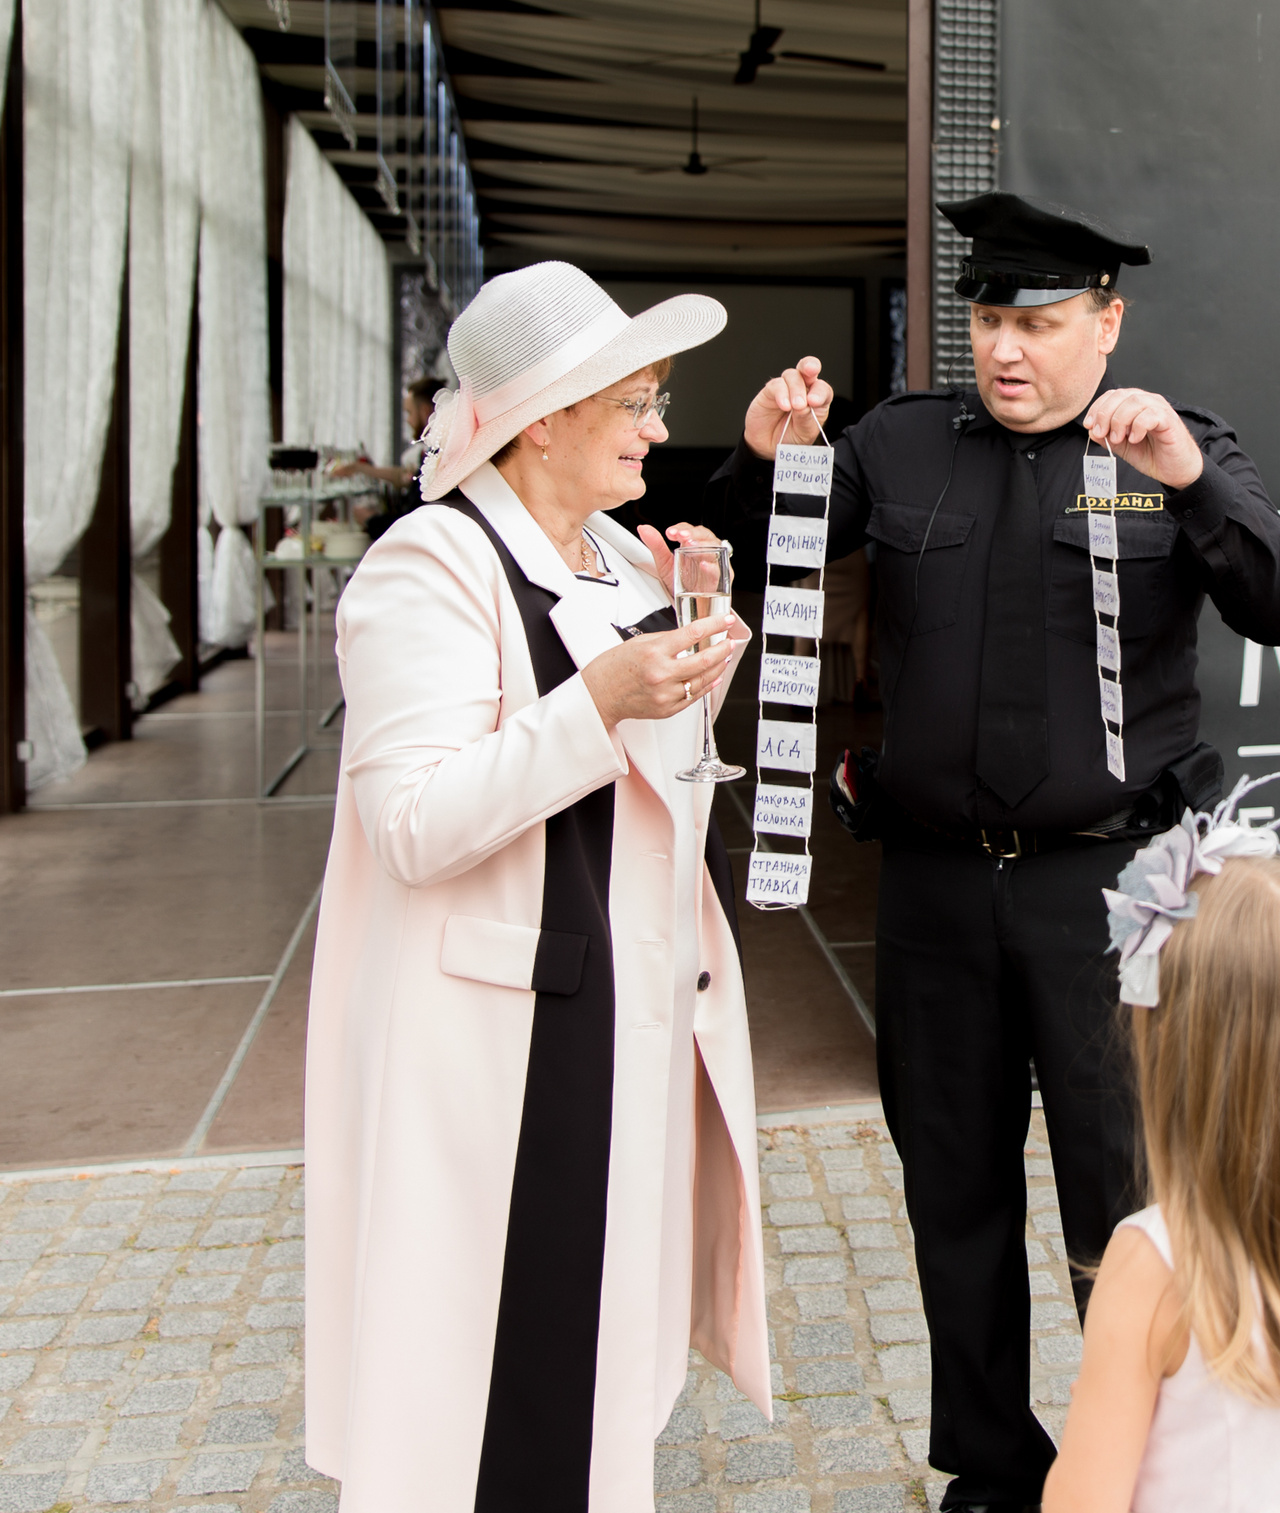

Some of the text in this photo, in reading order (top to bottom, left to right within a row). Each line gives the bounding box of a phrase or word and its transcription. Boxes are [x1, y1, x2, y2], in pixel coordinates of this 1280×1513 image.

[1086, 497, 1154, 508] ОХРАНА
[768, 532, 825, 553] ГОРЫНЫЧ
[766, 599, 818, 621] КАКАИН
[761, 737, 800, 758] ЛСД
[756, 811, 804, 828] СОЛОМКА
[752, 860, 808, 876] СТРАННАЯ
[750, 877, 799, 896] ТРАВКА
